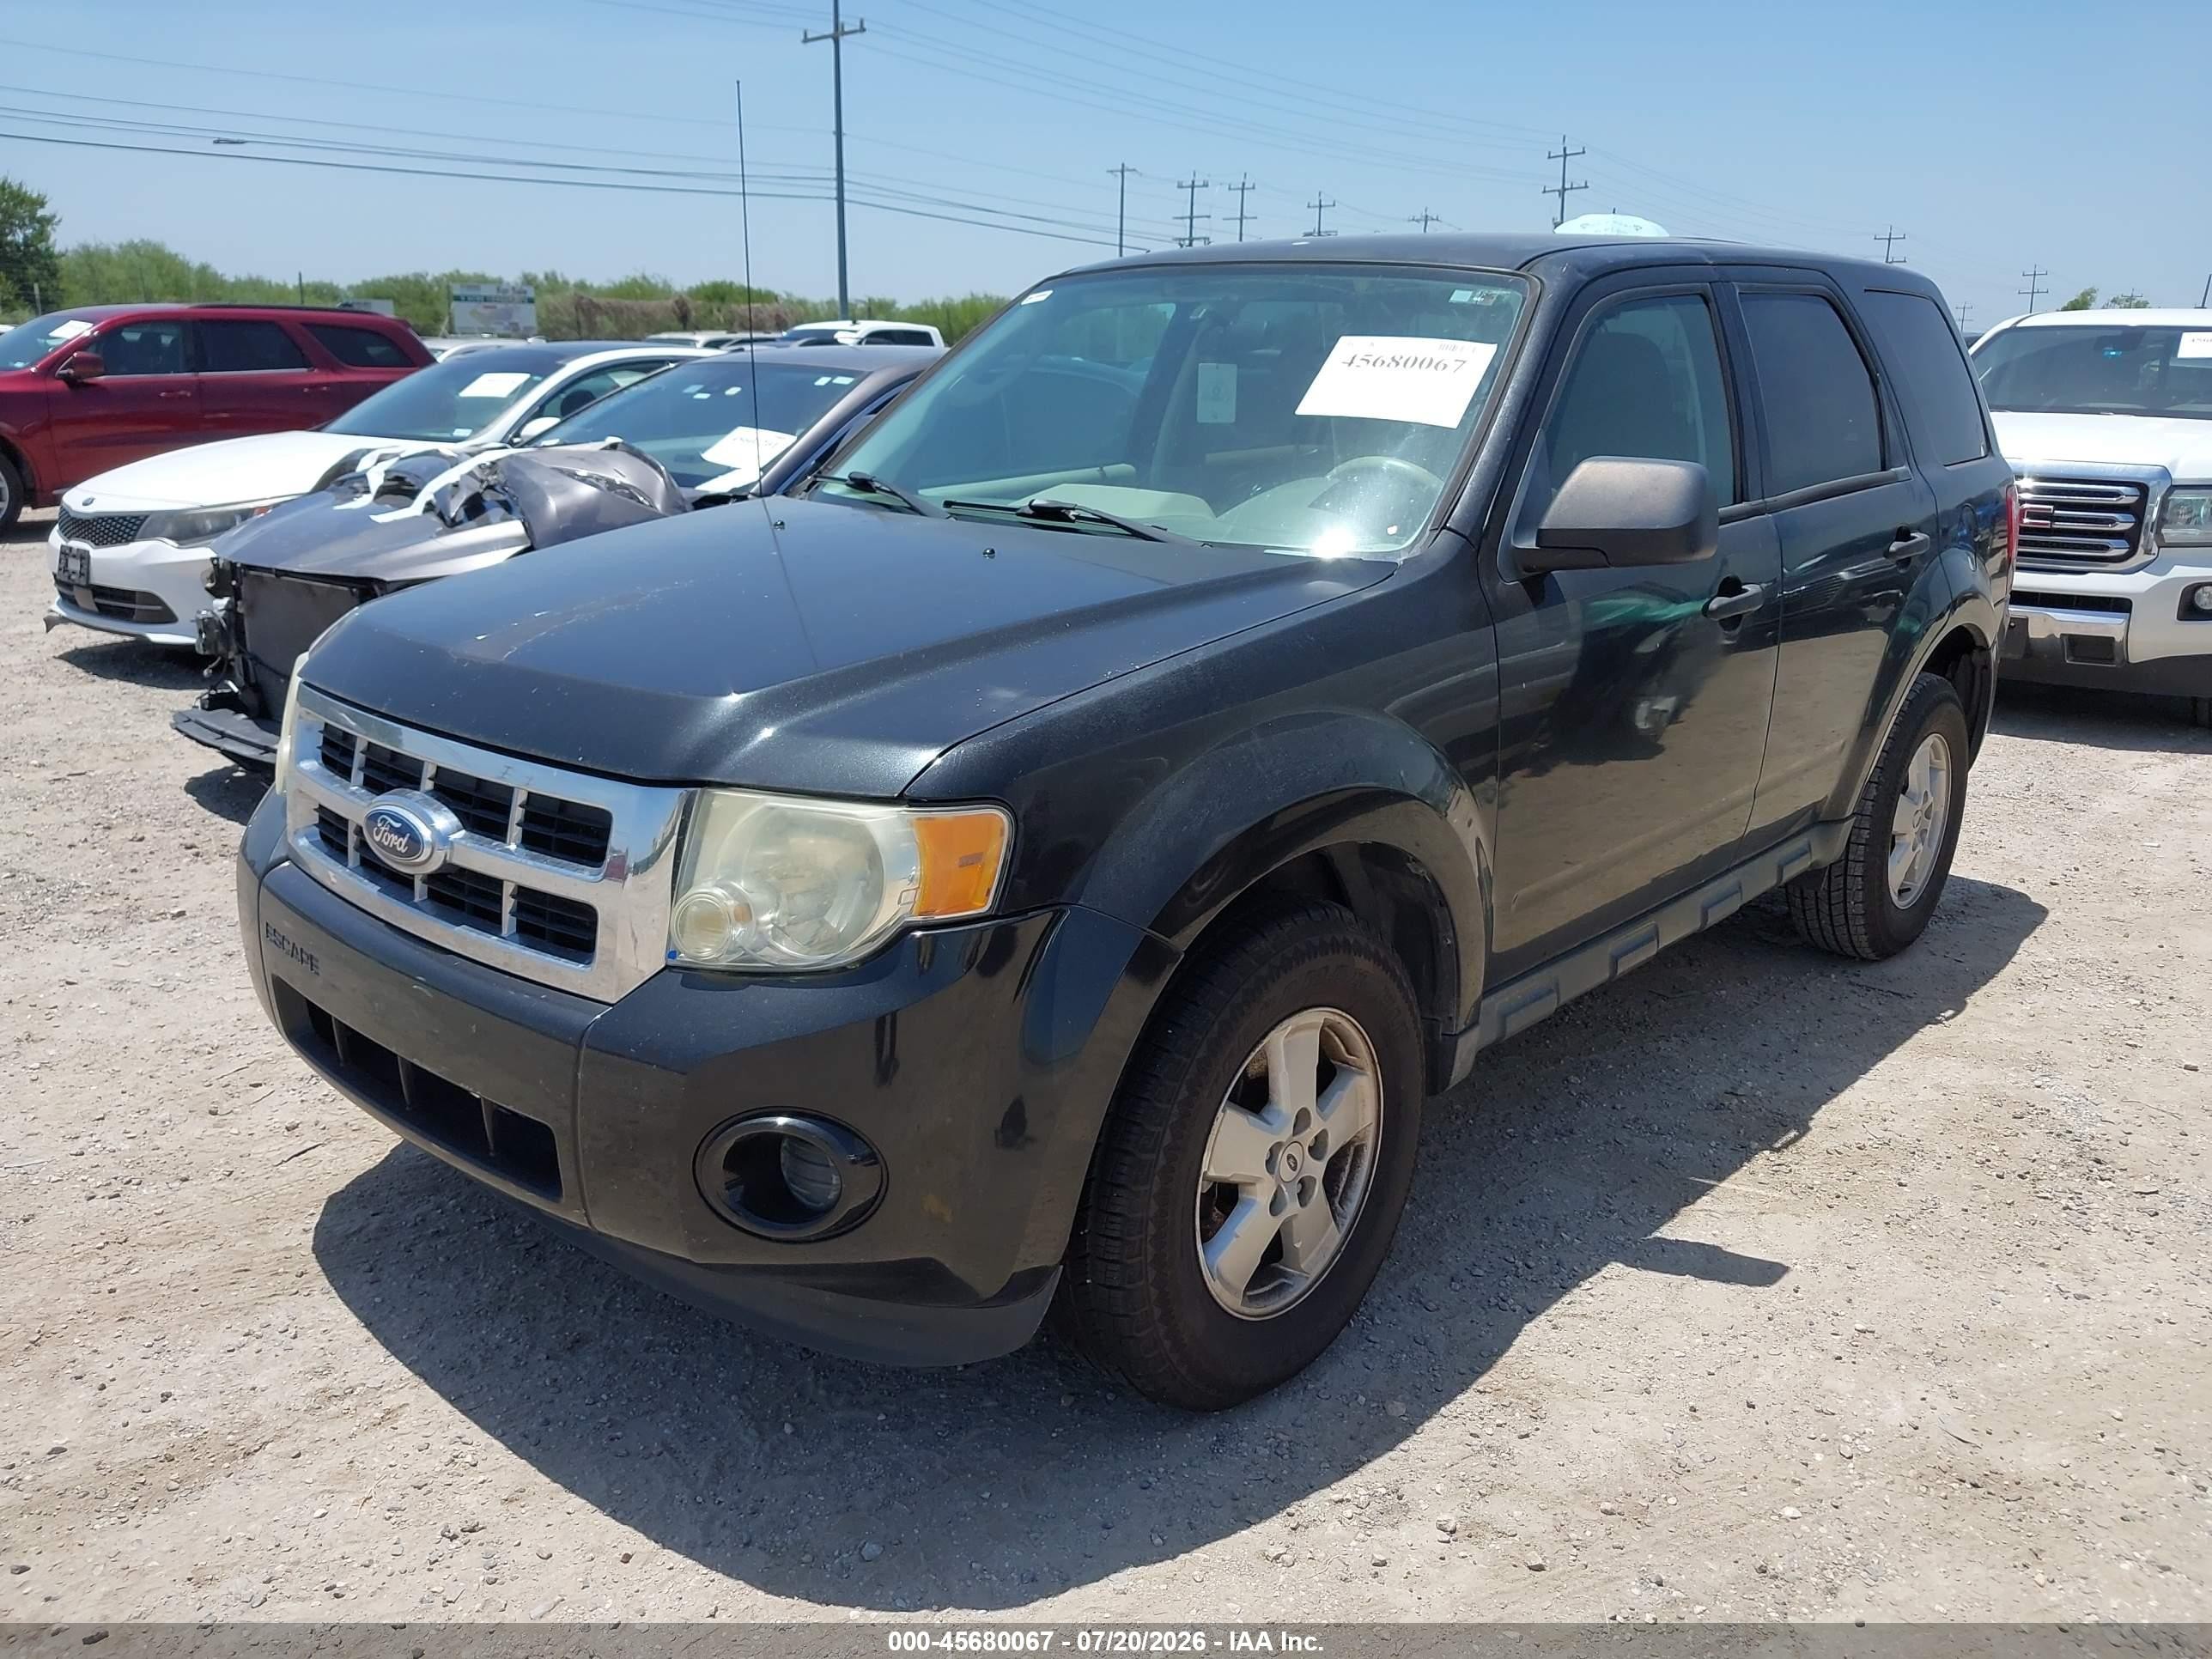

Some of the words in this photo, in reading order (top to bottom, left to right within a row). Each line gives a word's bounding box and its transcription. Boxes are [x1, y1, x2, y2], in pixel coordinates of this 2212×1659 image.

[1341, 354, 1468, 373] 45680067
[374, 815, 410, 853] Ford
[265, 921, 320, 976] ESCAPE
